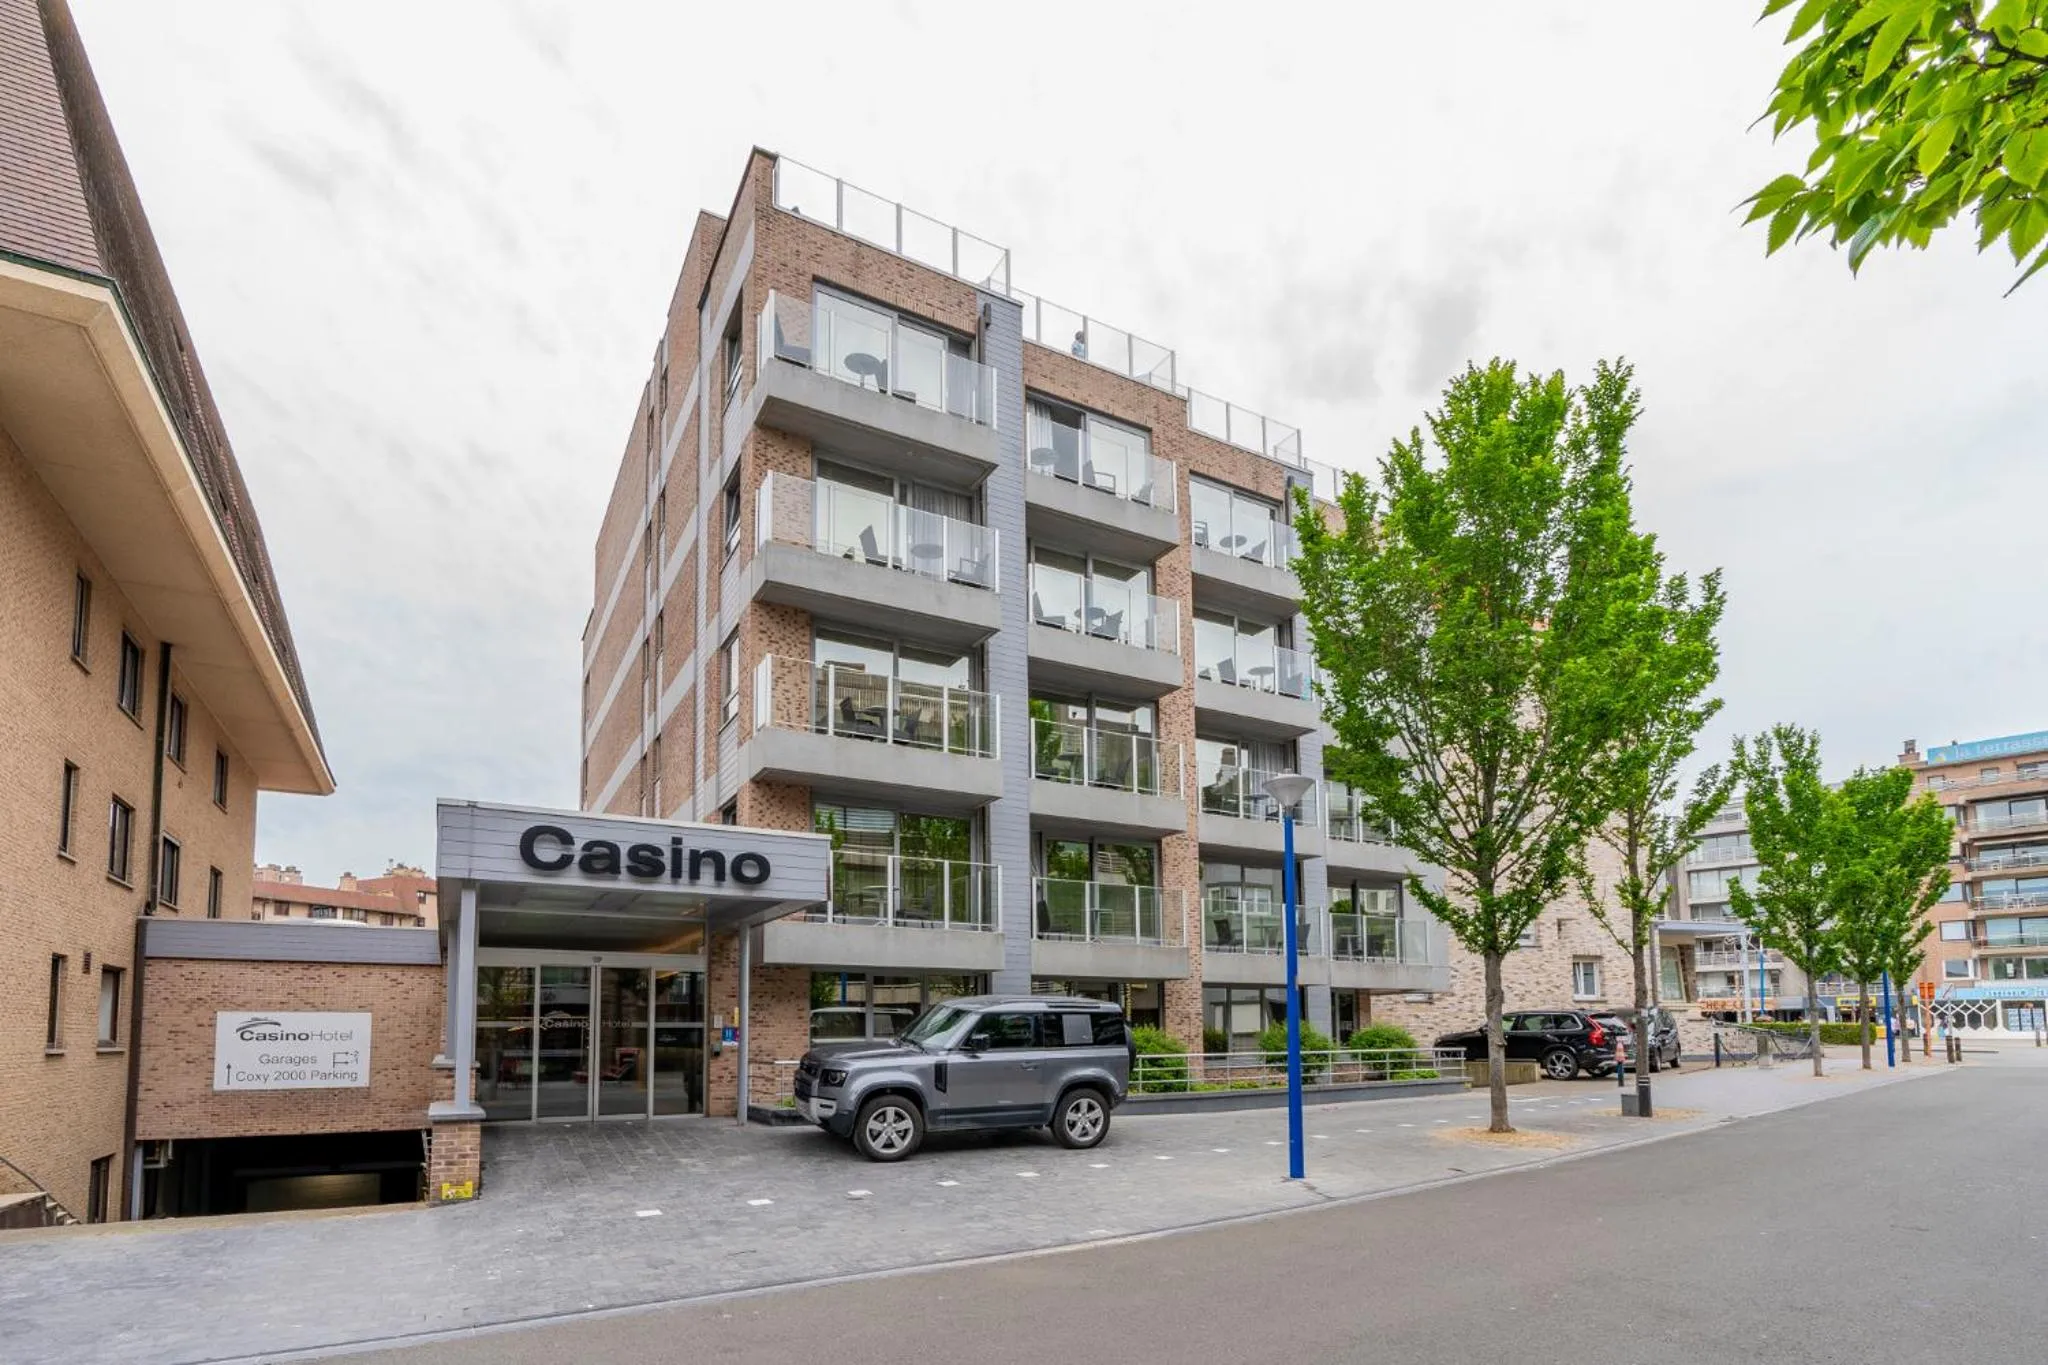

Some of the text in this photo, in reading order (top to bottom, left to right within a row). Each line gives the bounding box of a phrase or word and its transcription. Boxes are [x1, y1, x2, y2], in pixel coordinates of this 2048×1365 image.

[519, 825, 771, 885] Casino
[544, 1018, 588, 1029] Casino
[258, 1053, 318, 1067] Garages
[235, 1070, 358, 1083] Coxy 2000 Parking
